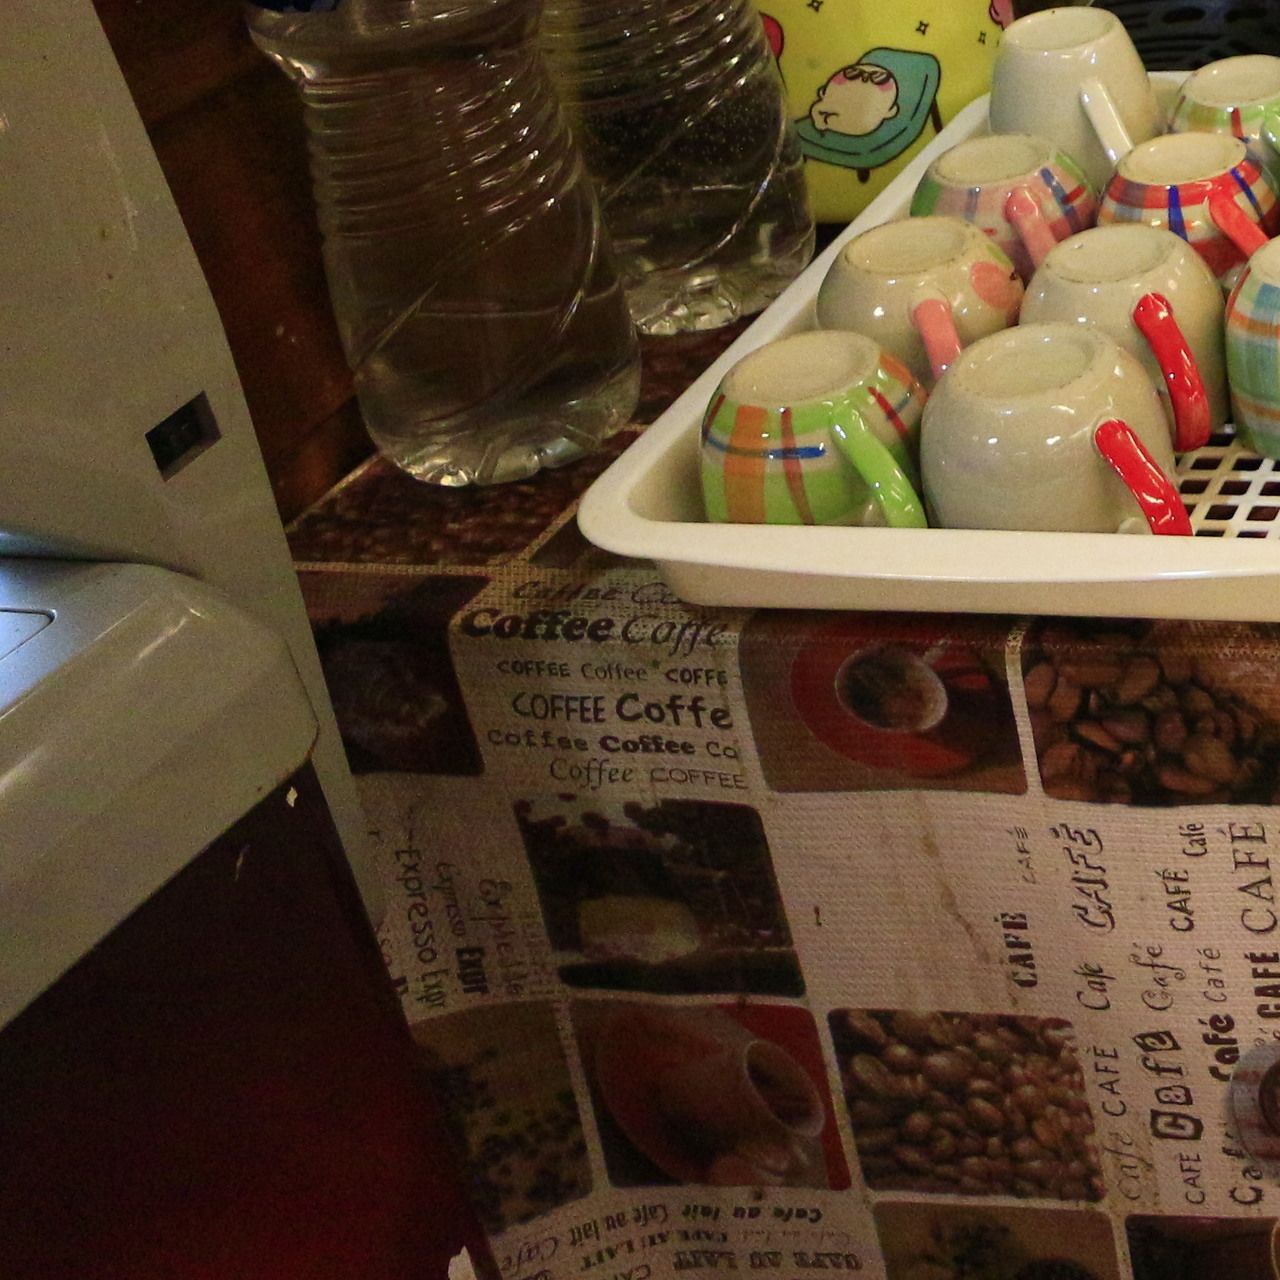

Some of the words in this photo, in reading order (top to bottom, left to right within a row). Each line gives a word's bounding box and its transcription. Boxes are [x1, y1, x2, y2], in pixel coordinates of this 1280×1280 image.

[461, 608, 614, 642] Coffee
[496, 660, 570, 678] COFFEE
[581, 662, 648, 681] Coffee
[512, 692, 606, 723] COFFEE
[616, 693, 733, 730] Coffe
[488, 730, 588, 751] Coffee
[600, 735, 695, 754] Coffee
[707, 742, 737, 759] Co
[550, 758, 634, 790] Coffee
[650, 769, 749, 790] COFFEE
[1179, 823, 1207, 857] Café
[1217, 822, 1278, 934] CAFÉ
[1155, 869, 1194, 932] CAFÉ
[1197, 948, 1227, 1002] Café
